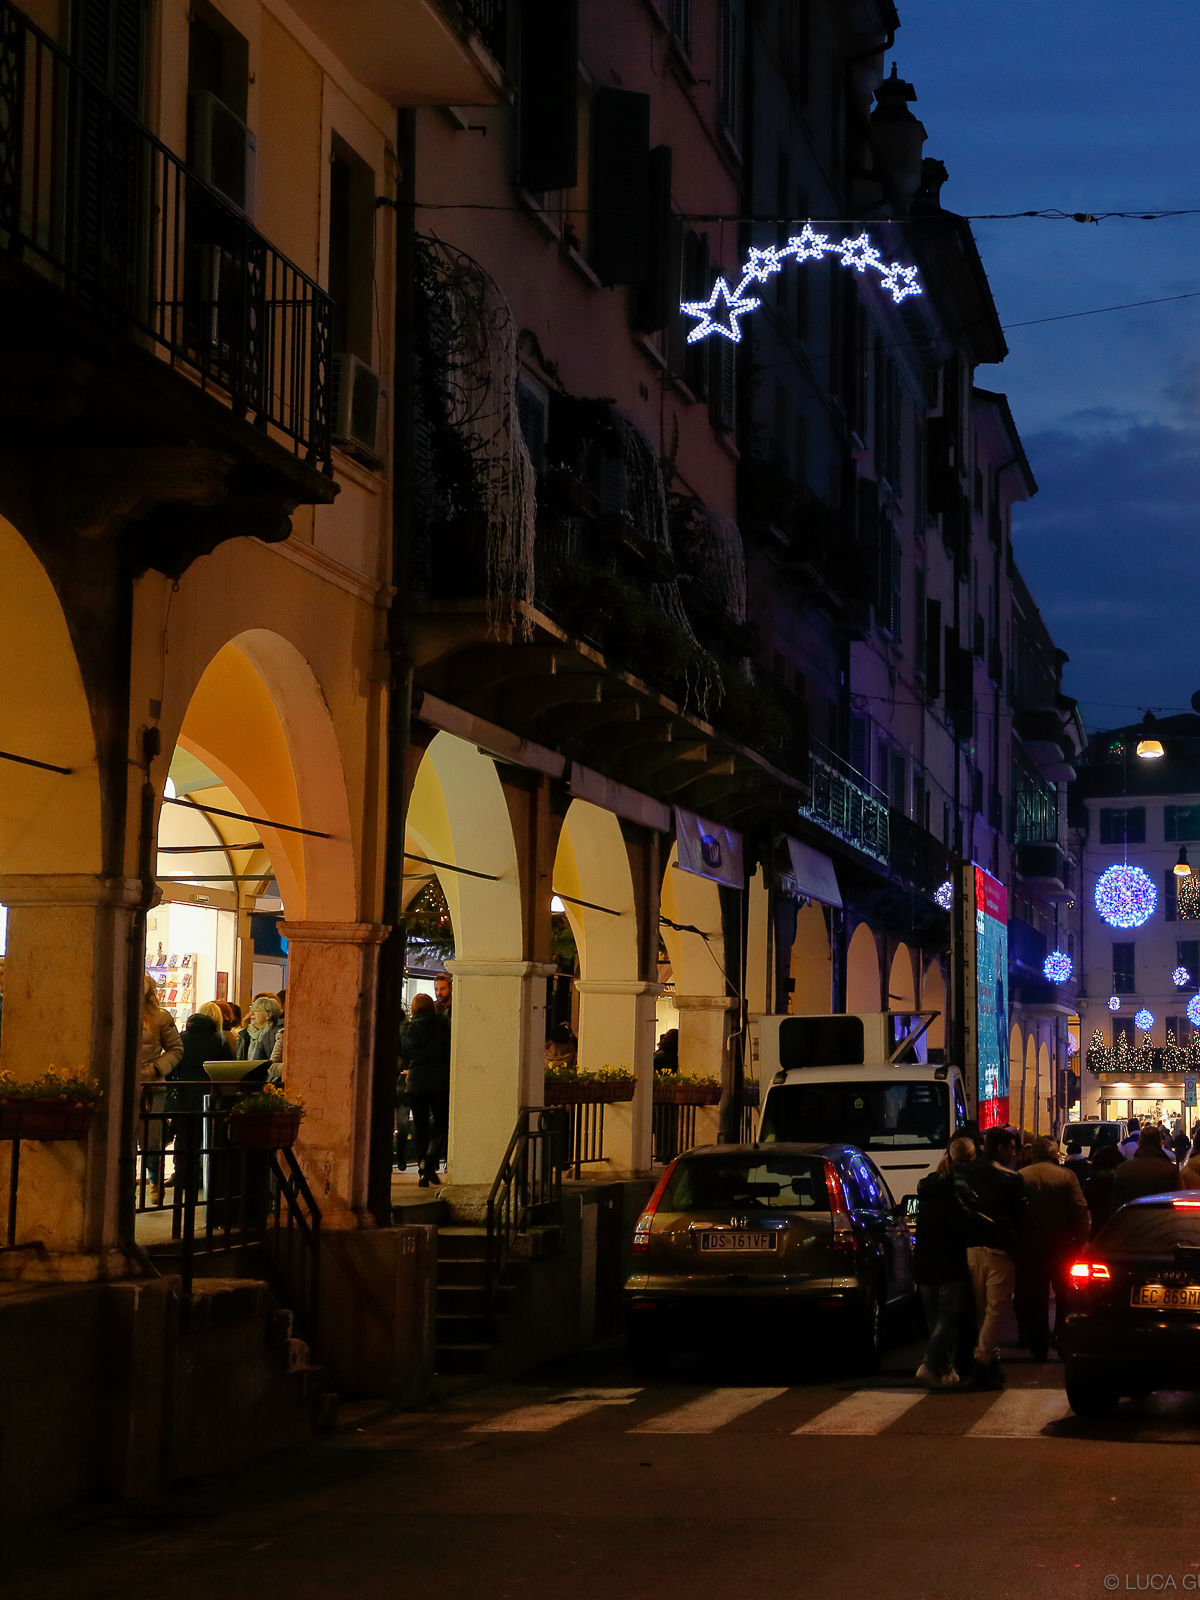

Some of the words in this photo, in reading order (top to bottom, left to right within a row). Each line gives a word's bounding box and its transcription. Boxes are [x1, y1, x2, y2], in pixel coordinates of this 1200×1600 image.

[711, 1235, 726, 1248] DS
[731, 1235, 769, 1248] 161VF
[1142, 1289, 1158, 1304] EC
